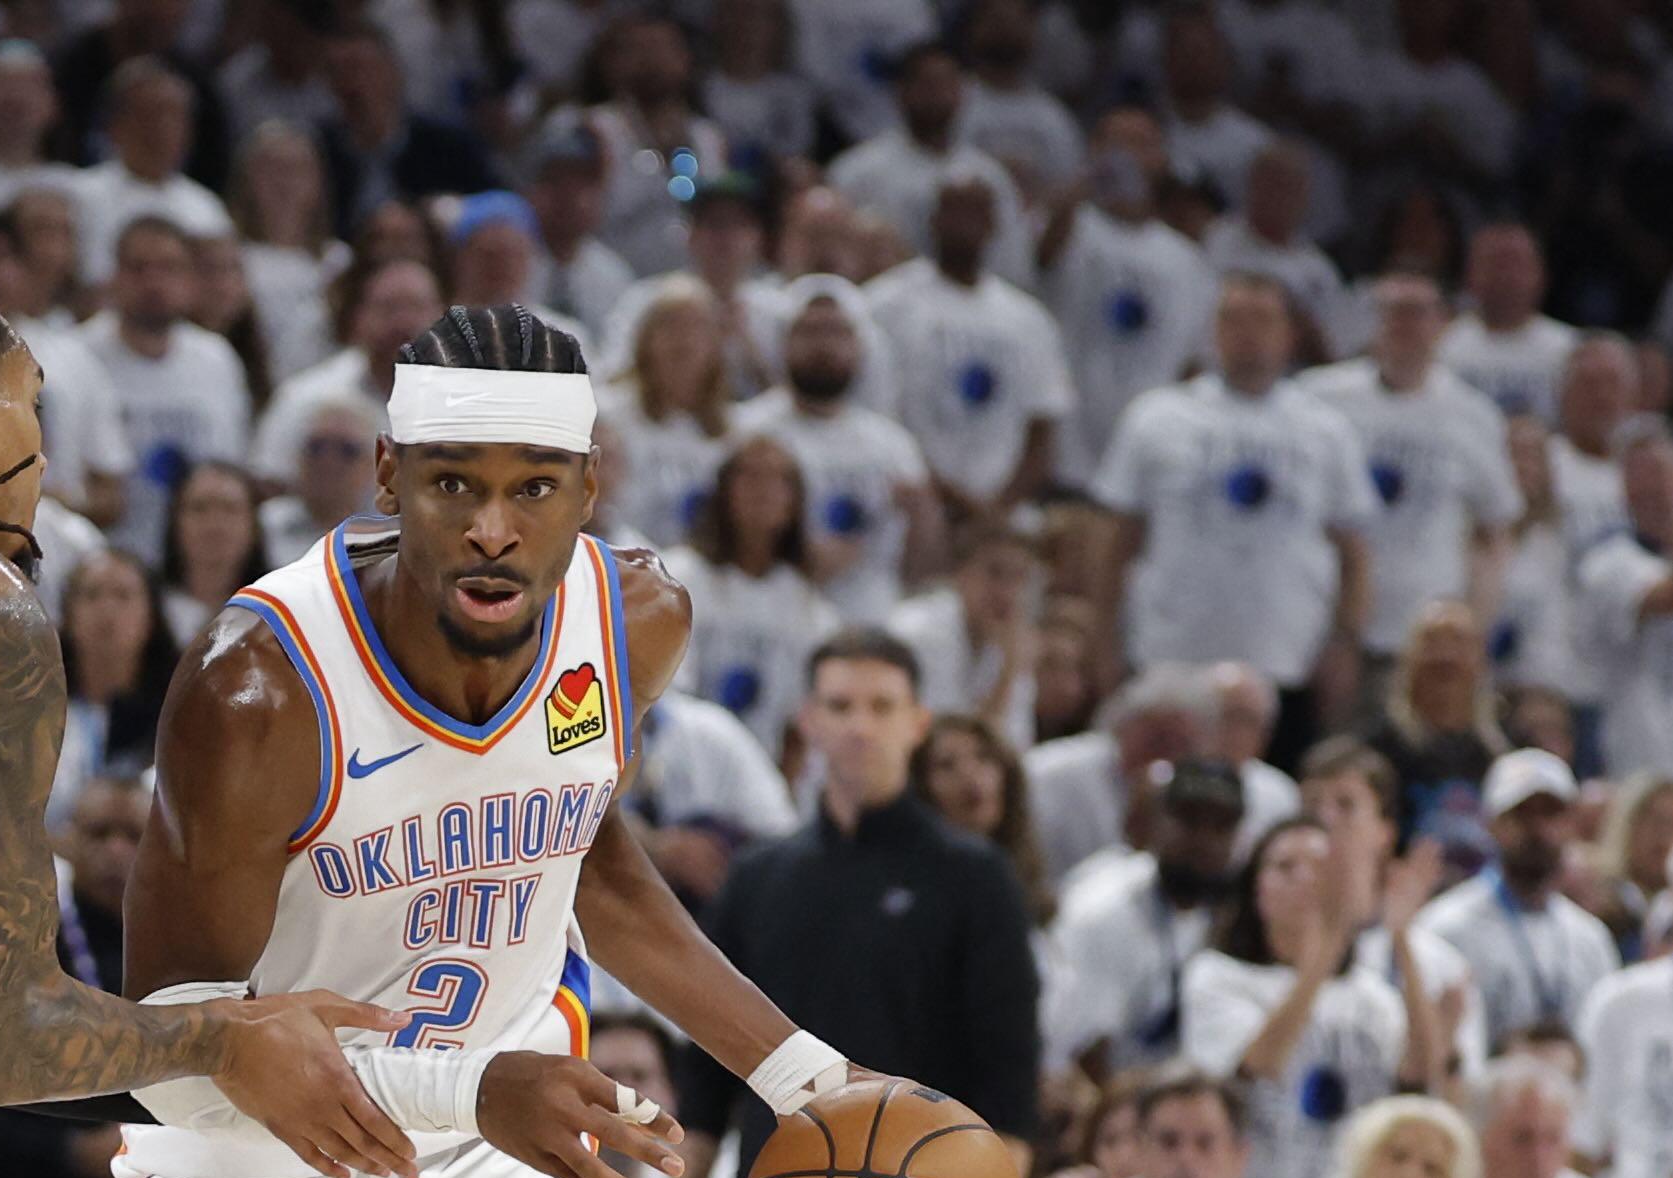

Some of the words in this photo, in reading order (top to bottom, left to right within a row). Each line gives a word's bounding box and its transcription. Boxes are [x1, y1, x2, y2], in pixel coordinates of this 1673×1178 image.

[308, 779, 615, 899] OKLAHOMA
[403, 872, 543, 950] CITY
[386, 957, 490, 1050] 2
